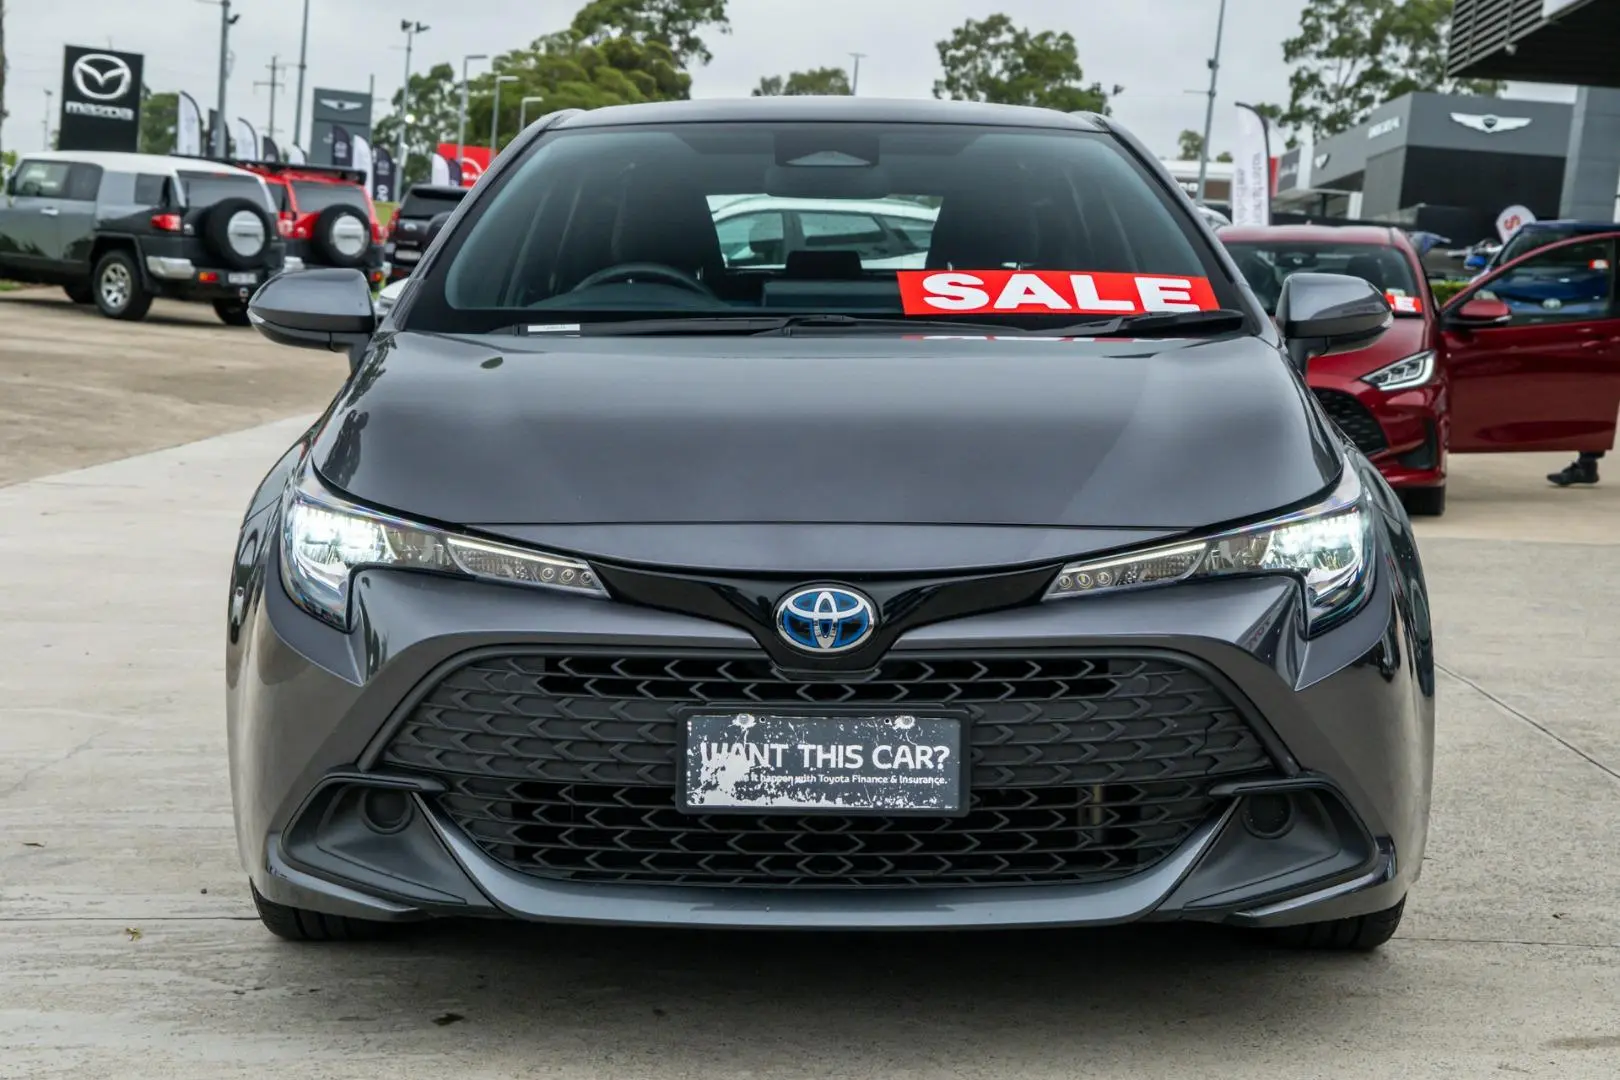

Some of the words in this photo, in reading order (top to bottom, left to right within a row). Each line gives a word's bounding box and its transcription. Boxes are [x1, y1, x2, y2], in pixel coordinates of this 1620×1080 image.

[922, 273, 1201, 312] SALE
[700, 742, 789, 768] WANT
[797, 744, 864, 769] THIS
[871, 744, 951, 770] CAR?
[760, 773, 794, 785] happen
[795, 773, 817, 783] with
[818, 774, 850, 785] Toyota
[852, 774, 888, 784] Finance
[889, 775, 897, 784] &
[899, 774, 948, 785] Insurance.
